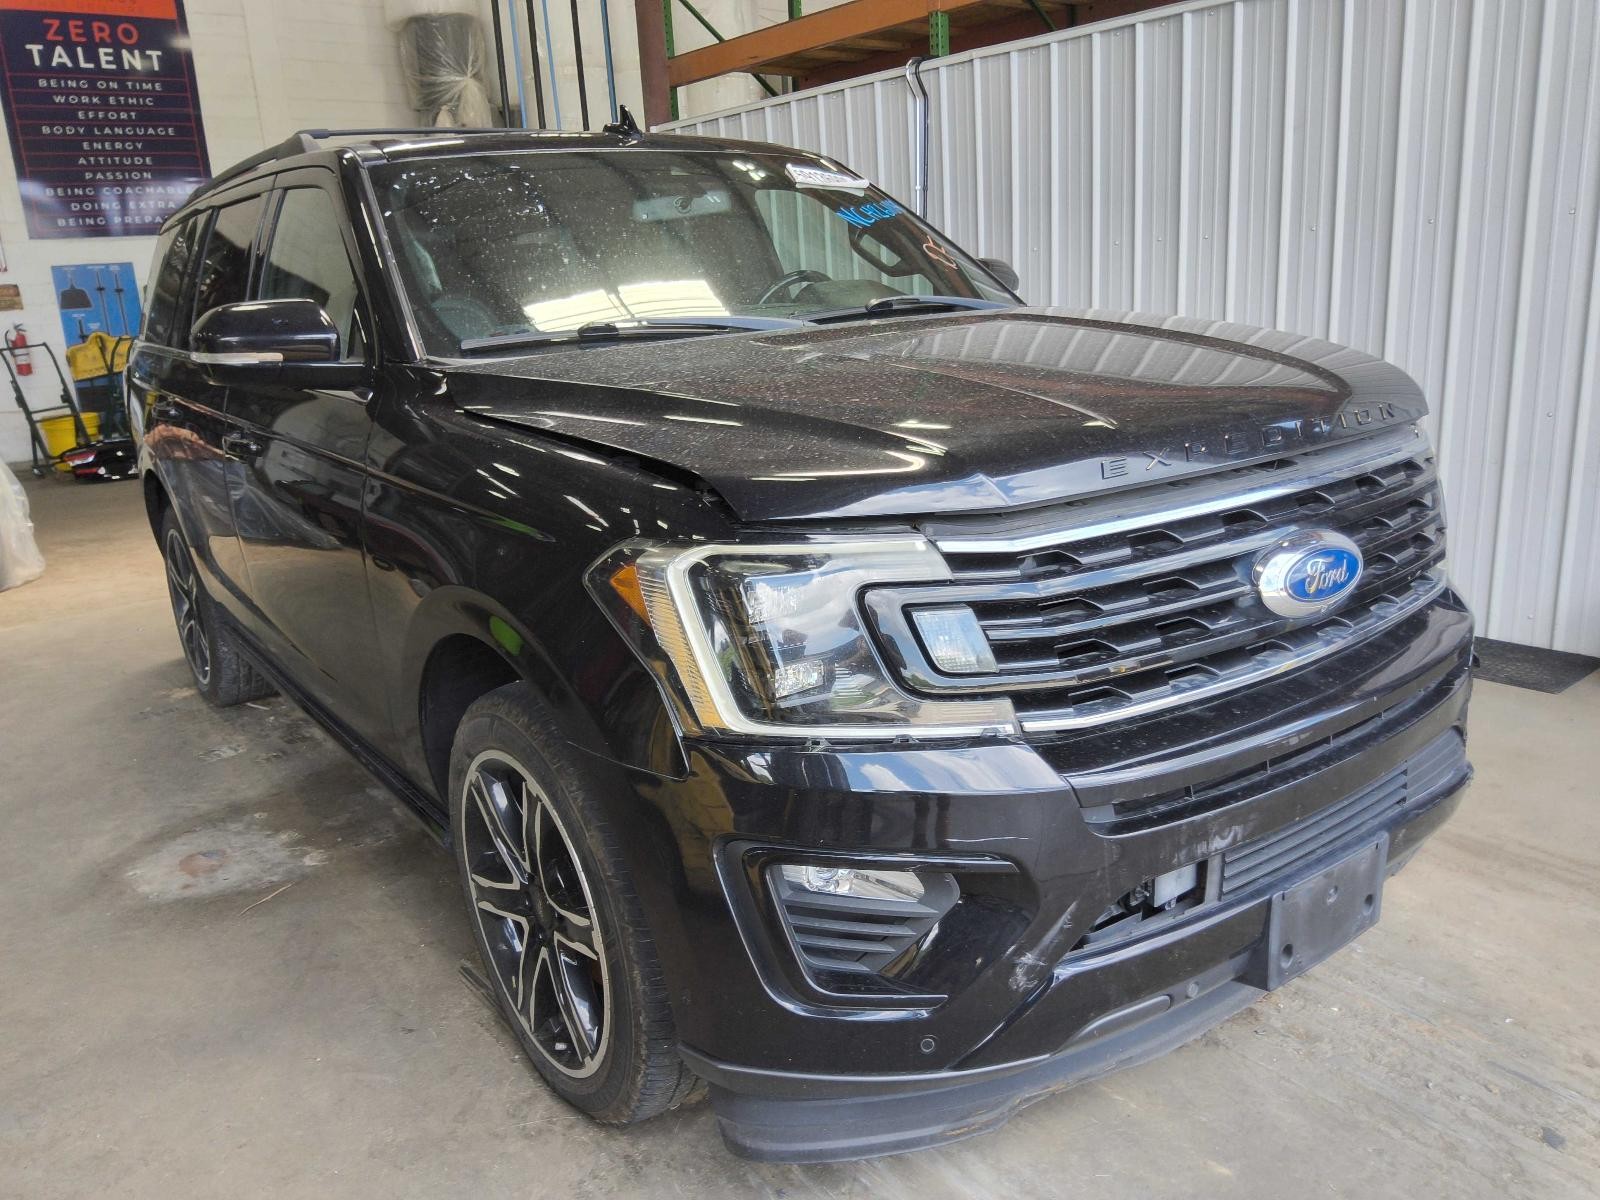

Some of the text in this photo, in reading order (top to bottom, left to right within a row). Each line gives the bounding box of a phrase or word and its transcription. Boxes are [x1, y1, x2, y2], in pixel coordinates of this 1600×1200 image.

[43, 19, 140, 44] ZERO
[25, 44, 162, 71] TALENT
[38, 79, 163, 91] BEING ON TIME
[53, 95, 154, 106] WORK ETHIC
[78, 111, 137, 120] EFFORT
[42, 126, 176, 136] BODY LANGUAGE
[83, 142, 143, 150] ENERGY
[78, 157, 153, 165] ATTITUDE
[85, 172, 152, 180] PASSION
[45, 187, 95, 197] BEING
[71, 202, 121, 211] DOING
[57, 216, 169, 227] BEING PREPA
[1101, 402, 1396, 480] EXPEDITION
[1305, 556, 1350, 594] Ford
